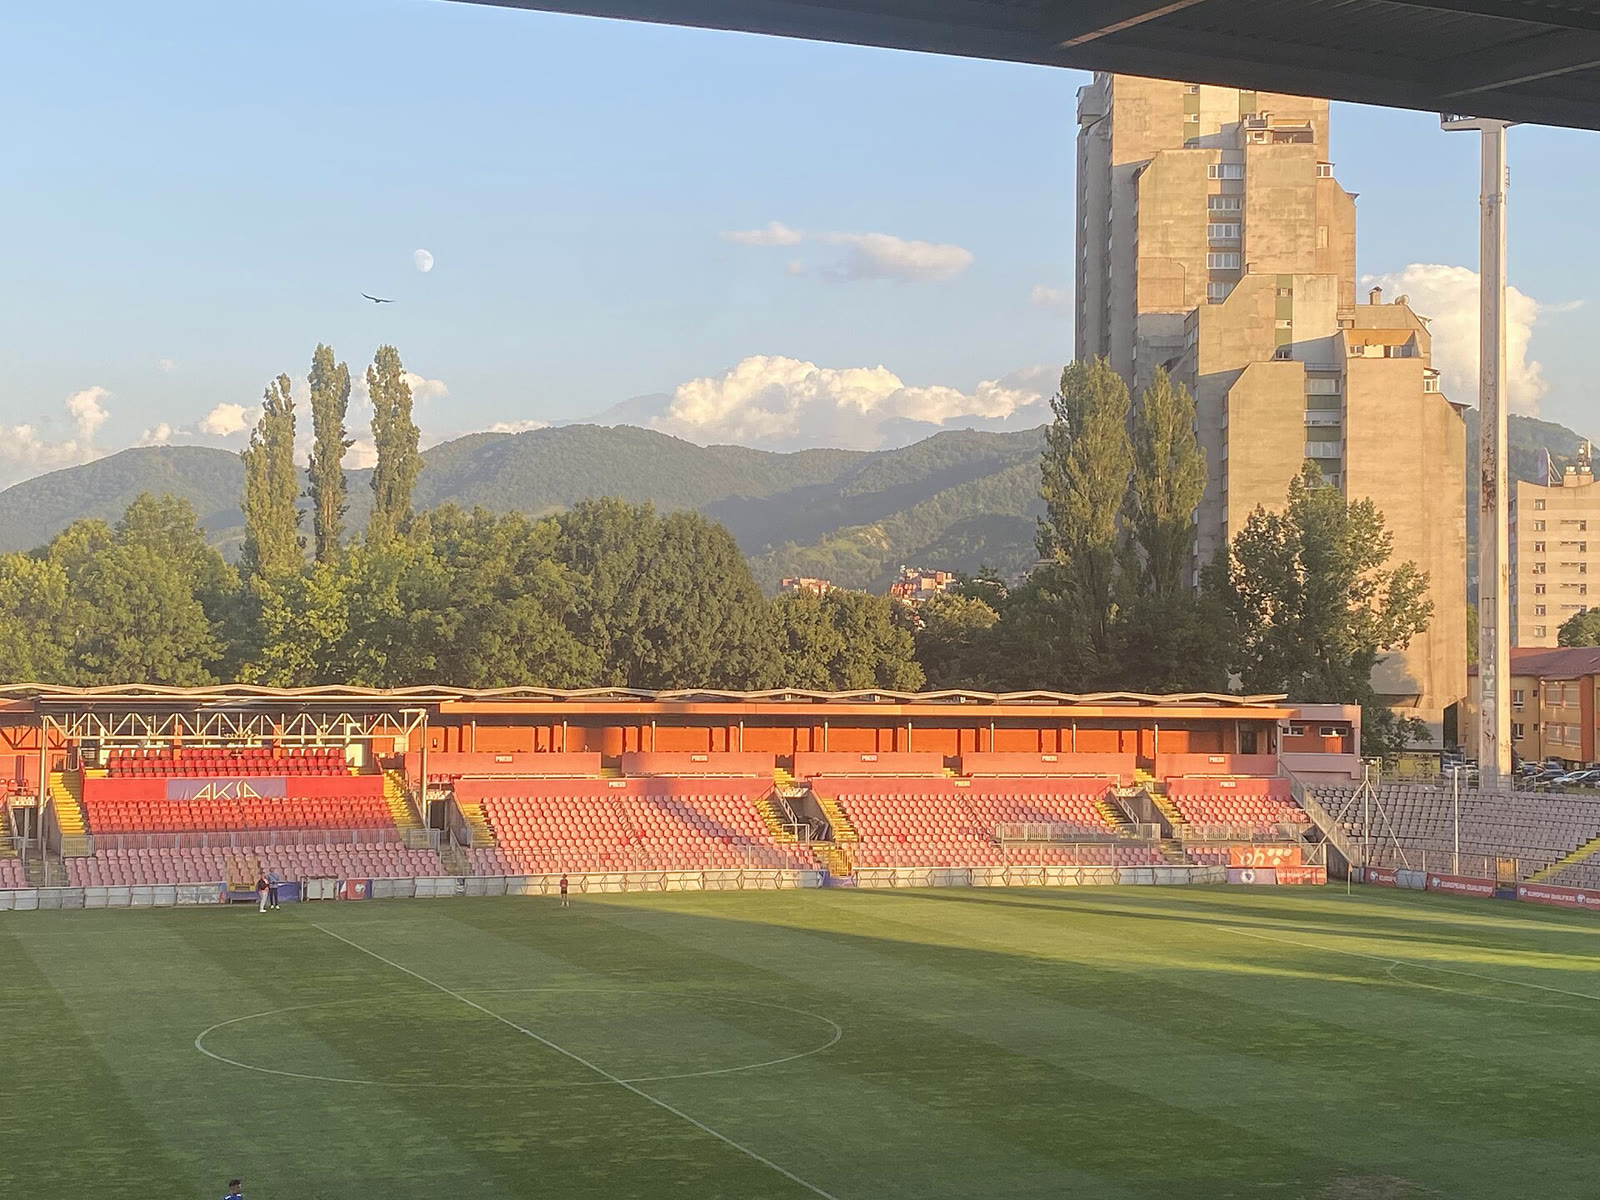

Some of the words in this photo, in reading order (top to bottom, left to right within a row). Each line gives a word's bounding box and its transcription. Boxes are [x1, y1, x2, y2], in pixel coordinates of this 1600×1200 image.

[192, 779, 262, 800] AKSA
[1441, 881, 1465, 889] EUROPEAN
[1467, 884, 1493, 893] QUALIFIERS
